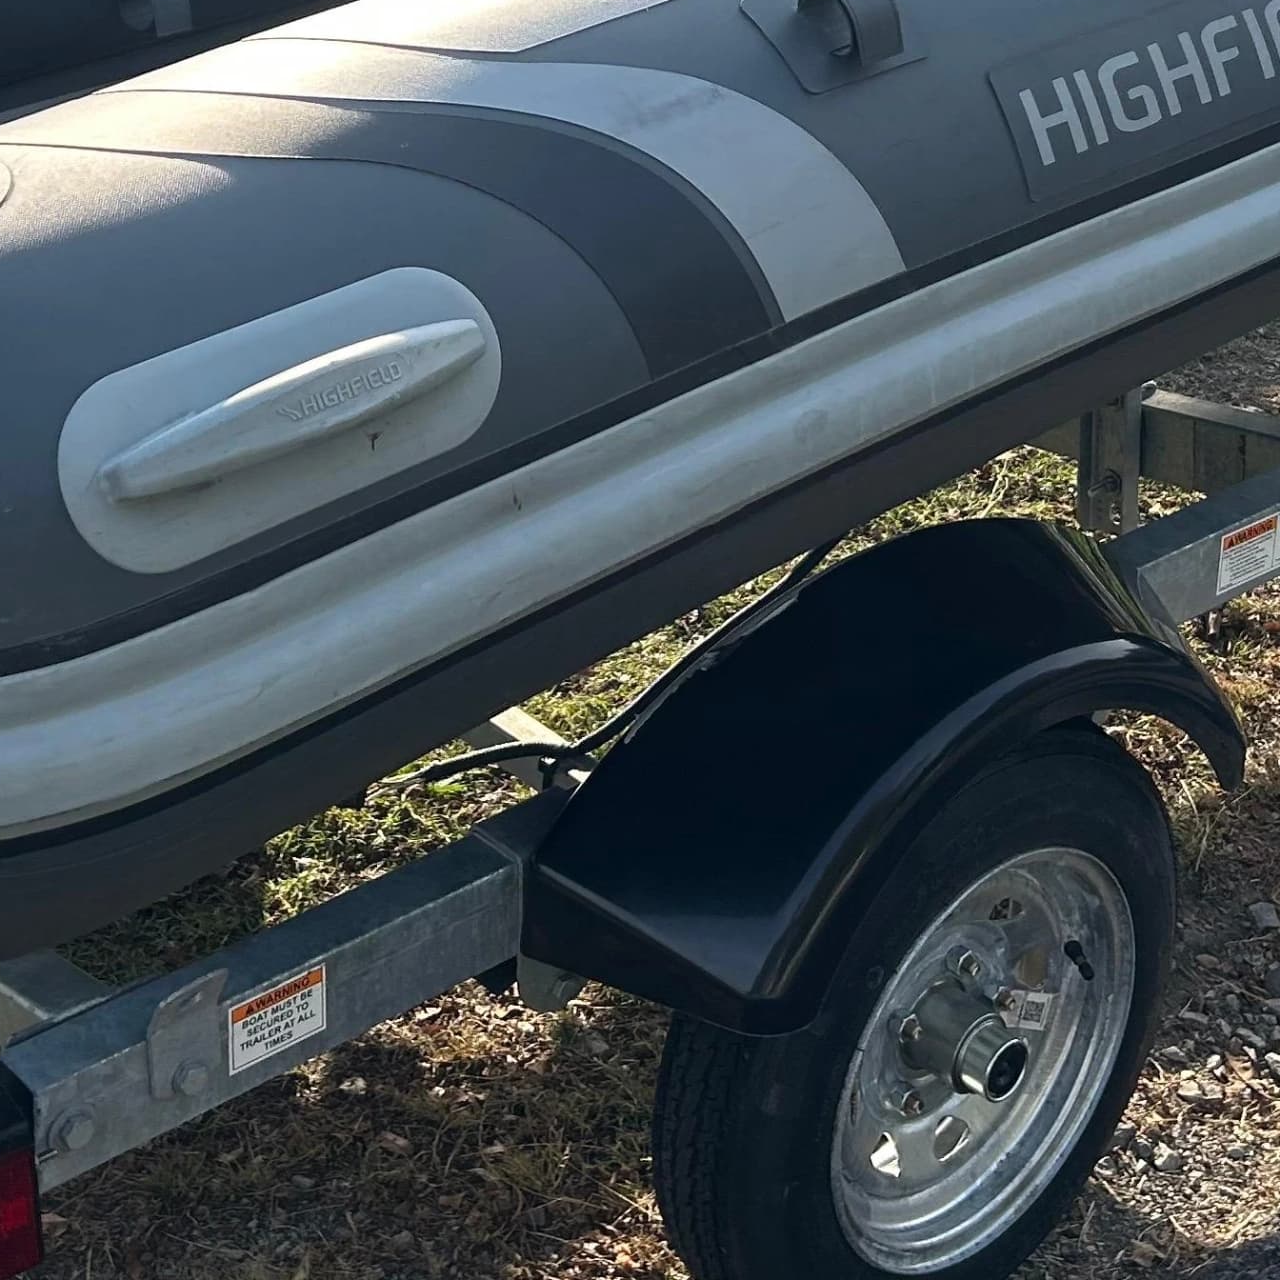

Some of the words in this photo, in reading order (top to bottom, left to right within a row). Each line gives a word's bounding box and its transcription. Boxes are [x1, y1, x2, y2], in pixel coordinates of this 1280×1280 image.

[300, 360, 403, 416] HIGHFIELD
[1235, 519, 1273, 544] WARNING
[241, 1011, 268, 1030] BOAT
[271, 998, 298, 1018] MUST
[300, 989, 313, 1002] BE
[255, 976, 310, 1010] WARNING
[240, 1026, 282, 1052] TRAILER
[283, 1020, 295, 1032] AT
[297, 1009, 316, 1024] ALL
[247, 1010, 293, 1037] SECURED
[296, 1002, 309, 1014] TO
[264, 1031, 293, 1051] TIMES
